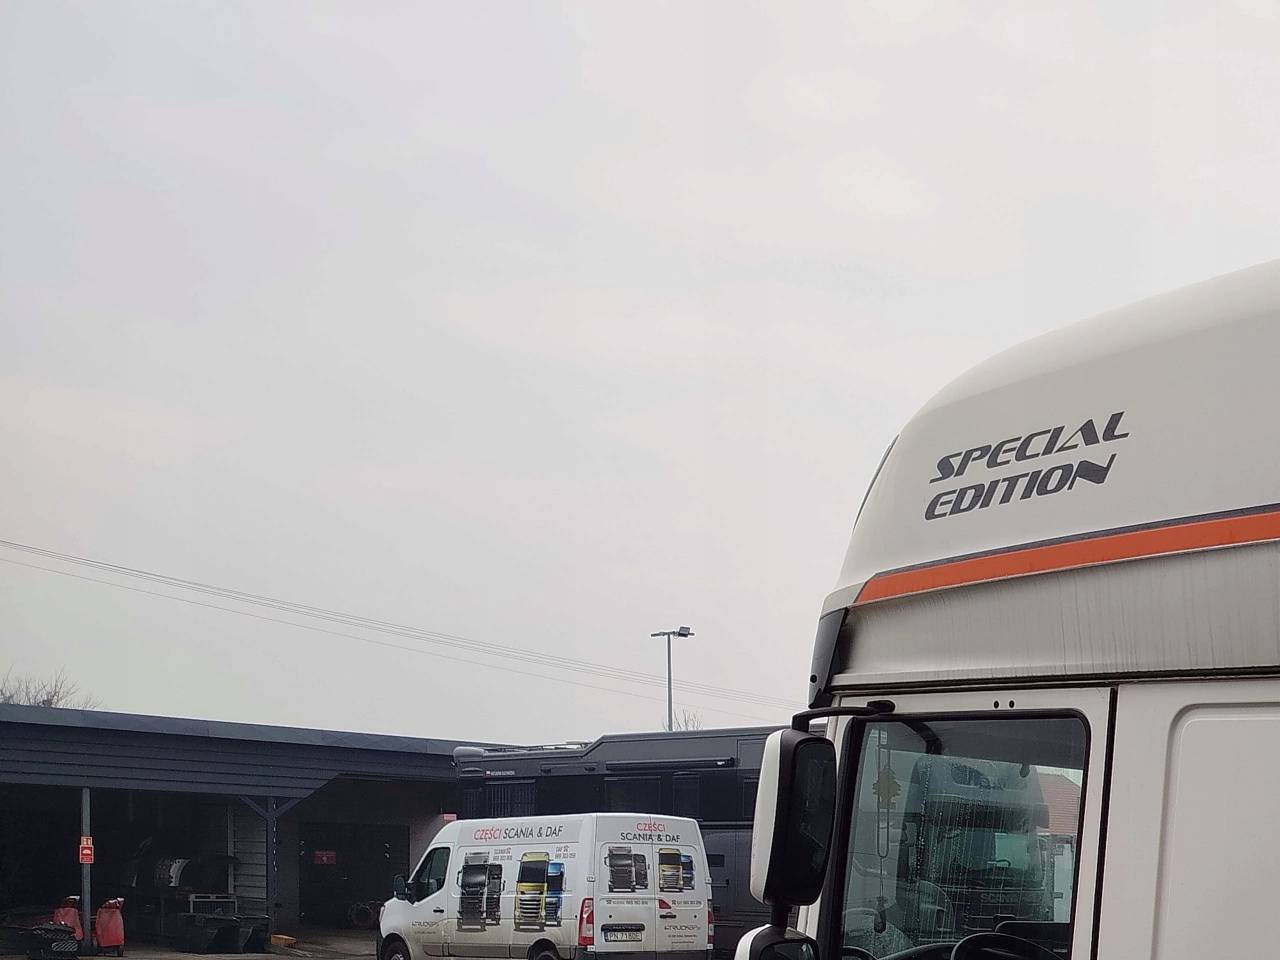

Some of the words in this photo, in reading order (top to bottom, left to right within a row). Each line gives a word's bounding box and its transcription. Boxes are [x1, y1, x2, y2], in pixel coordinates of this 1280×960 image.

[929, 411, 1130, 484] SPECIAL
[925, 453, 1117, 520] EDITION
[474, 826, 502, 842] CZĘŚCI
[503, 827, 534, 839] SCANIA
[537, 825, 544, 838] &
[546, 825, 564, 837] DAF
[620, 832, 654, 841] SCANIA
[657, 833, 663, 841] &
[665, 834, 681, 842] DAF
[609, 932, 619, 940] PN
